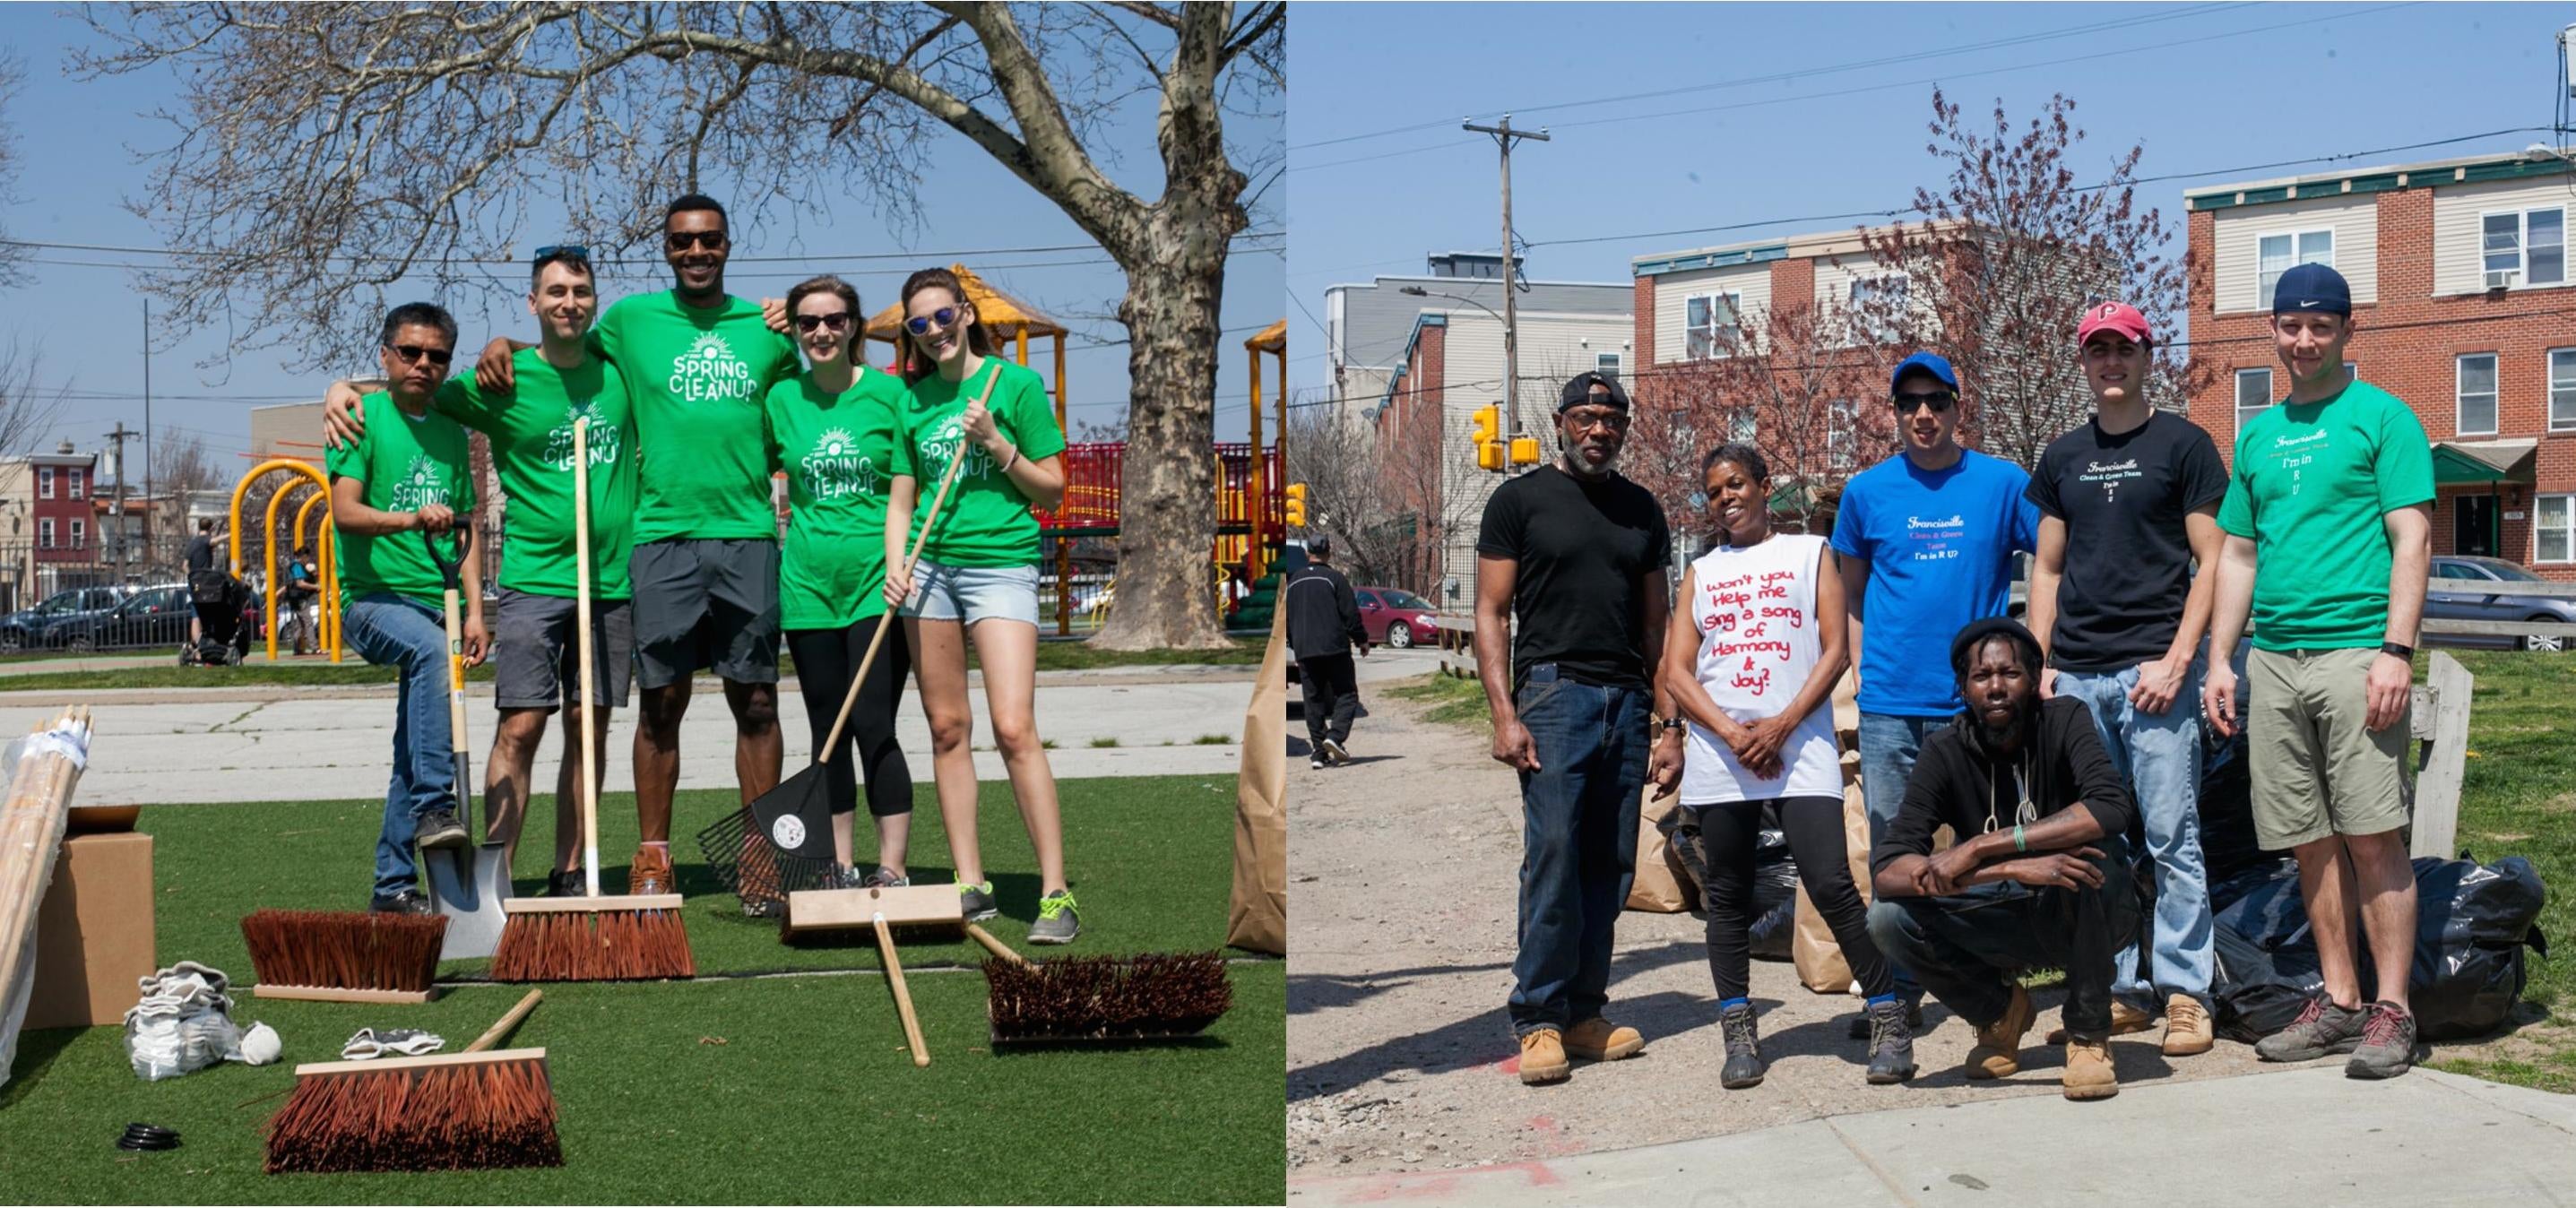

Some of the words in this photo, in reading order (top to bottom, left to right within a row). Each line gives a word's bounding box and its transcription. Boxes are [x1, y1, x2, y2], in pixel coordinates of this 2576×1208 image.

[2098, 302, 2119, 322] P
[673, 356, 748, 384] SPRING
[669, 375, 757, 402] CLEANUP
[549, 426, 618, 446] SPING
[801, 456, 872, 479] SPRING
[2087, 459, 2138, 473] Francisville
[2301, 453, 2312, 465] in
[2079, 474, 2098, 482] Clean
[1907, 514, 1965, 530] Francisville
[1915, 552, 1928, 560] I'm
[1929, 551, 1937, 560] in
[1938, 550, 1946, 559] R
[1760, 571, 1794, 589] you
[1713, 591, 1751, 608] Help
[1758, 586, 1788, 599] me
[1742, 609, 1754, 620] a
[1761, 607, 1802, 628] song
[1744, 622, 1768, 638] of
[1712, 641, 1791, 661] Harmony
[1742, 656, 1755, 671] &
[1731, 668, 1770, 695] Joy?
